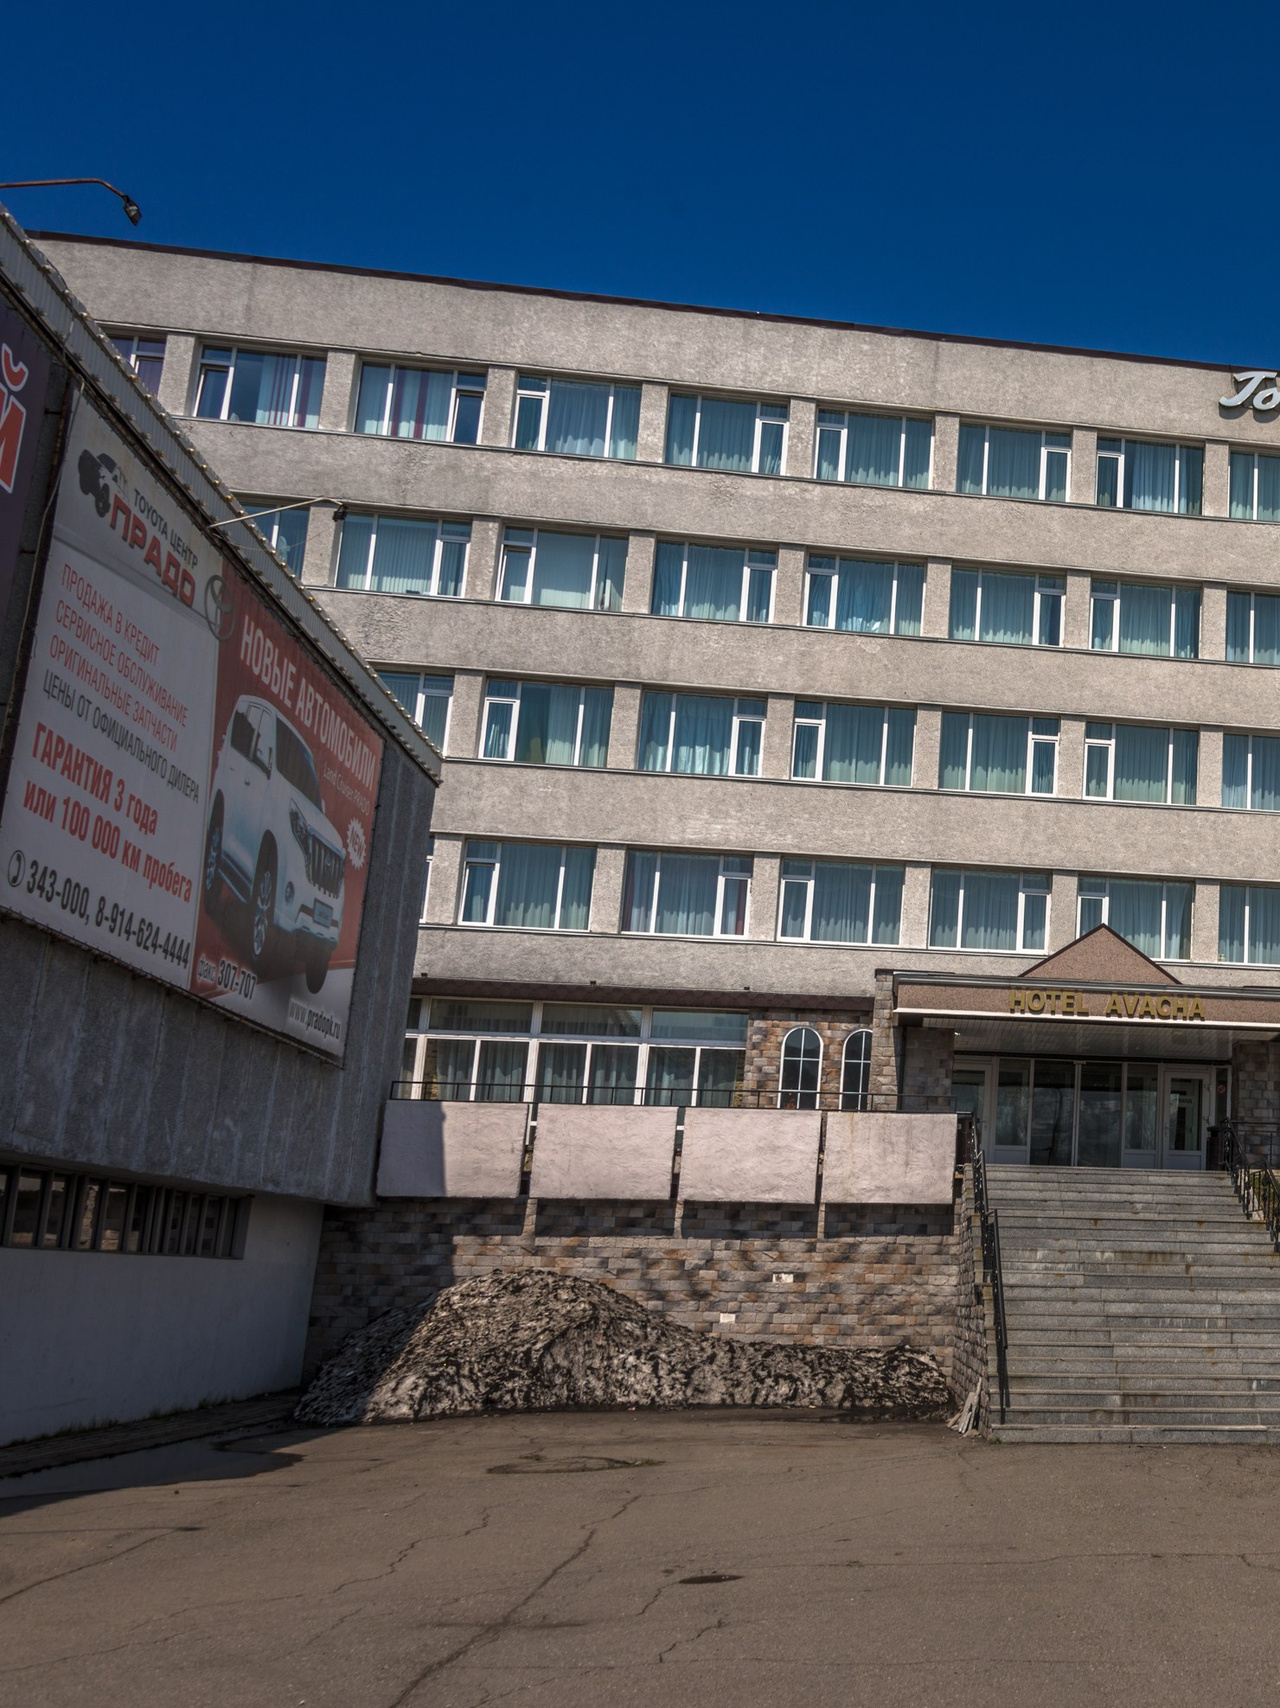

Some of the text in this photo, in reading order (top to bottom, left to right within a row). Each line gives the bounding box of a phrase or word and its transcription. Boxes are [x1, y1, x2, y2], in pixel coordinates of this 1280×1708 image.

[110, 493, 196, 608] ПРАДО
[134, 488, 198, 569] TOYOTA ЦЕНТР
[56, 599, 188, 728] СЕРВИСНОЕ ОБСЛУЖИВАНИЕ
[62, 563, 160, 666] ПРОДАЖА В КРЕДИТ
[43, 668, 199, 804] ЦЕНЫ ОТ ОФИЦИАЛЬНОГО ДИЛЕРА
[50, 634, 178, 753] ОРИГИНАЛЬНЫЕ ЗАПЧАСТИ
[240, 615, 377, 791] НОВЫЕ АВТОМОБИЛИ
[32, 721, 159, 836] ГАРАНТИЯ 3 года
[61, 796, 91, 842] 100
[91, 814, 121, 860] 000
[142, 853, 193, 904] пробега
[95, 895, 192, 970] 8-914-624-4444
[217, 958, 257, 1001] 307-707
[1009, 989, 1206, 1020] HOTEL AVACHA
